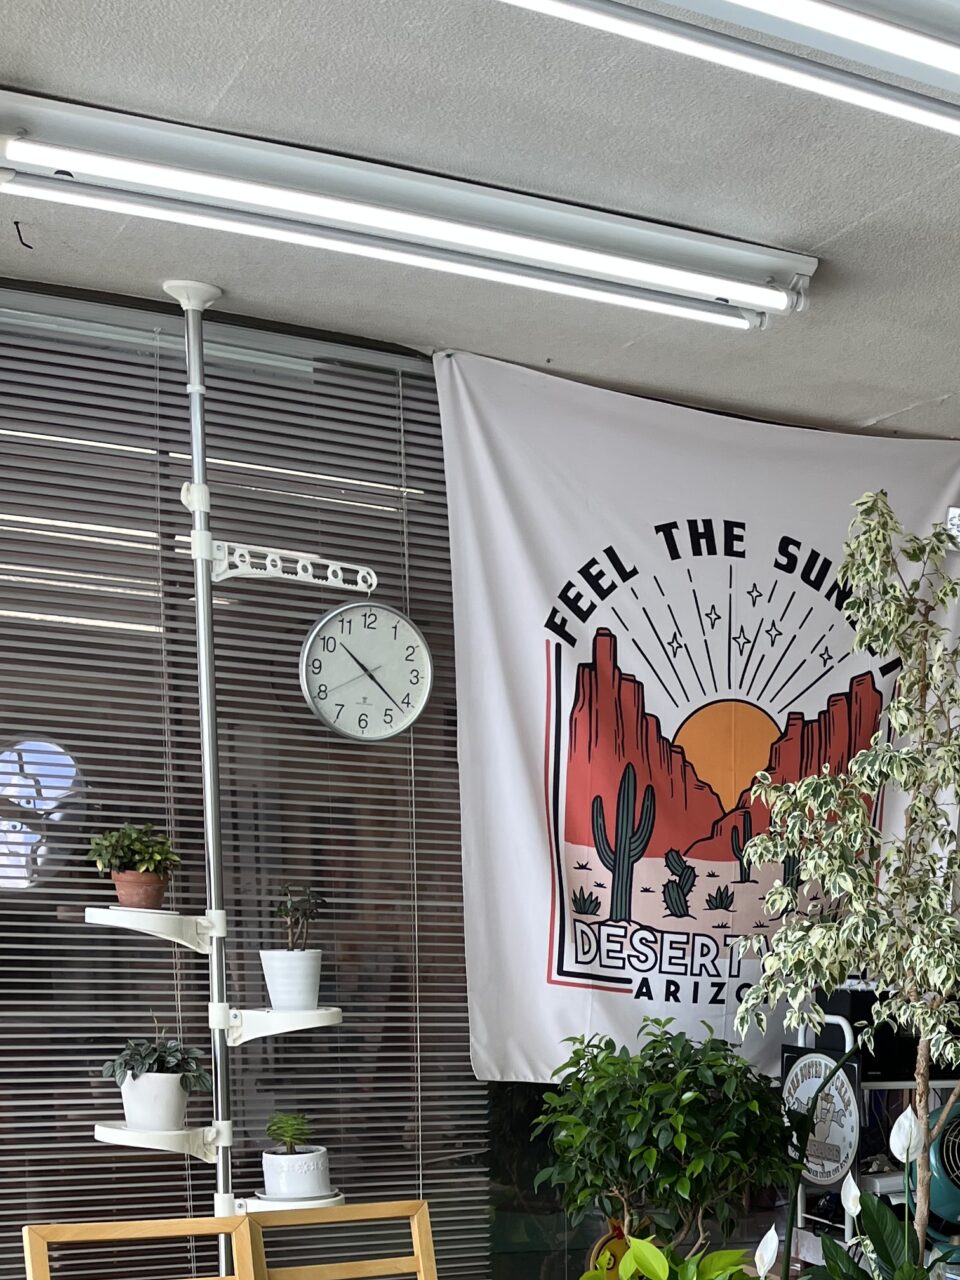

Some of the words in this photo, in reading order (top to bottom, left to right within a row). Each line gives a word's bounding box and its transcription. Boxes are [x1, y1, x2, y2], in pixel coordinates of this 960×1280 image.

[544, 545, 639, 648] FEEL
[654, 518, 746, 561] THE
[338, 618, 352, 635] 11
[362, 613, 377, 629] 12
[392, 624, 398, 640] 1
[320, 636, 336, 653] 10
[405, 646, 415, 661] 2
[311, 659, 322, 675] 9
[409, 669, 419, 685] 3
[317, 684, 327, 700] 8
[401, 692, 411, 708] 4
[335, 704, 344, 719] 7
[383, 709, 393, 724] 5
[358, 713, 368, 729] 6
[573, 919, 752, 978] DESERT
